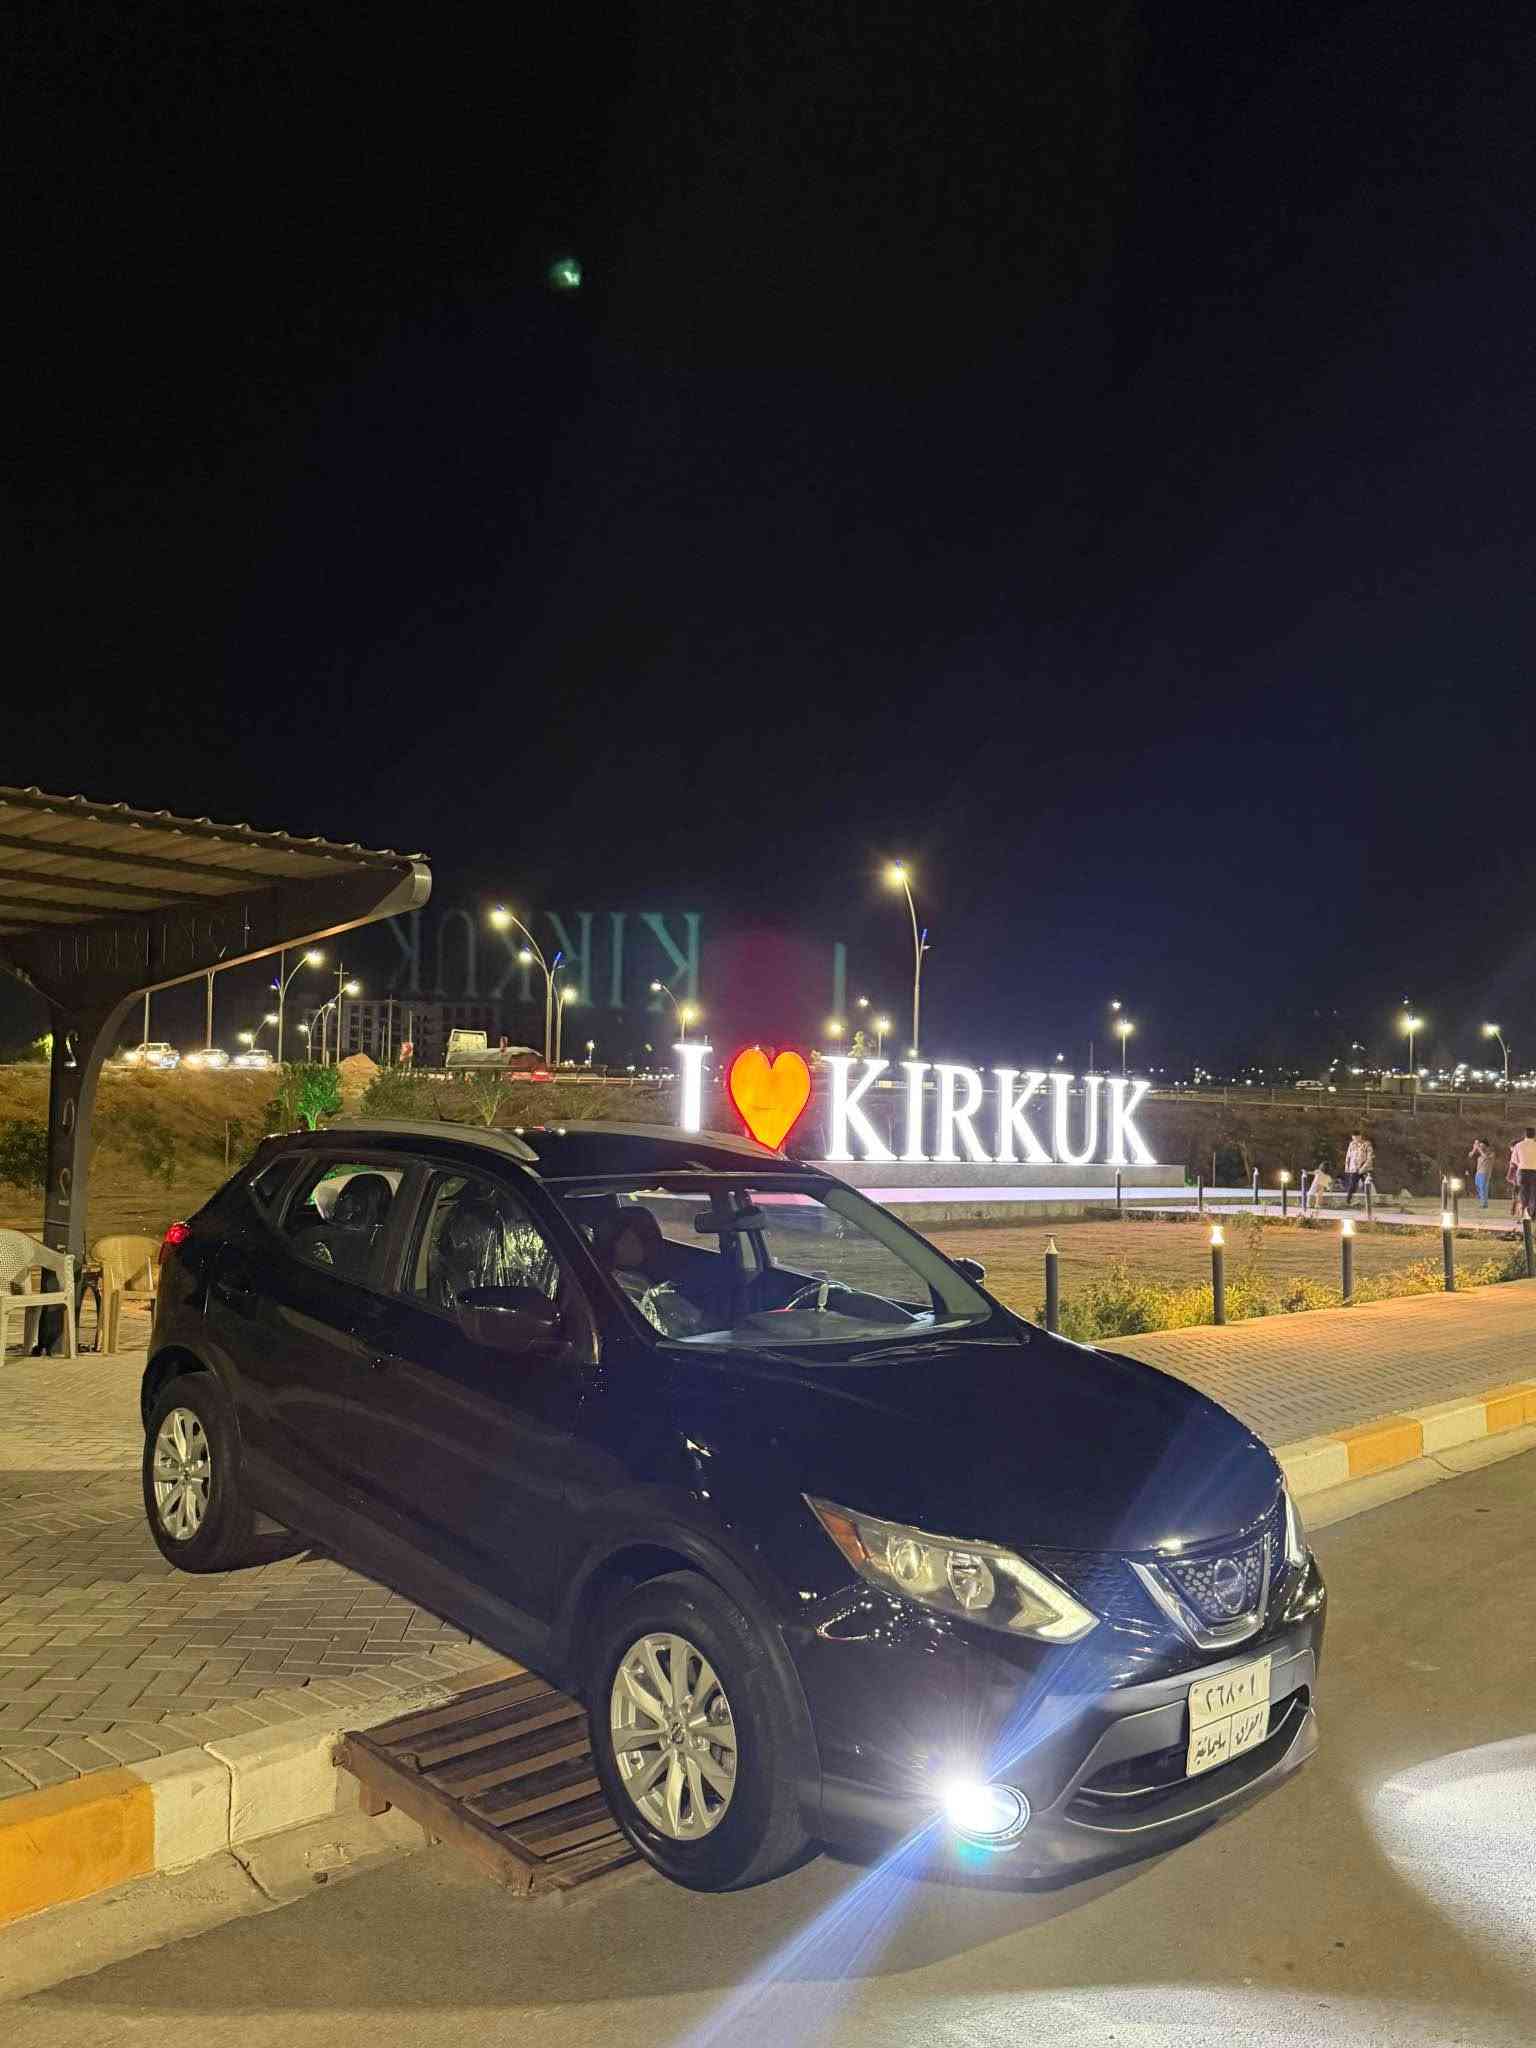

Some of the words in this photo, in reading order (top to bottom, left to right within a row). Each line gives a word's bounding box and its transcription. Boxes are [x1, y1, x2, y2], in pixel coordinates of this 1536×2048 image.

[673, 1043, 713, 1133] I
[821, 1055, 1158, 1164] KIRKUK
[1205, 1671, 1256, 1713] ٢٦٨٠١
